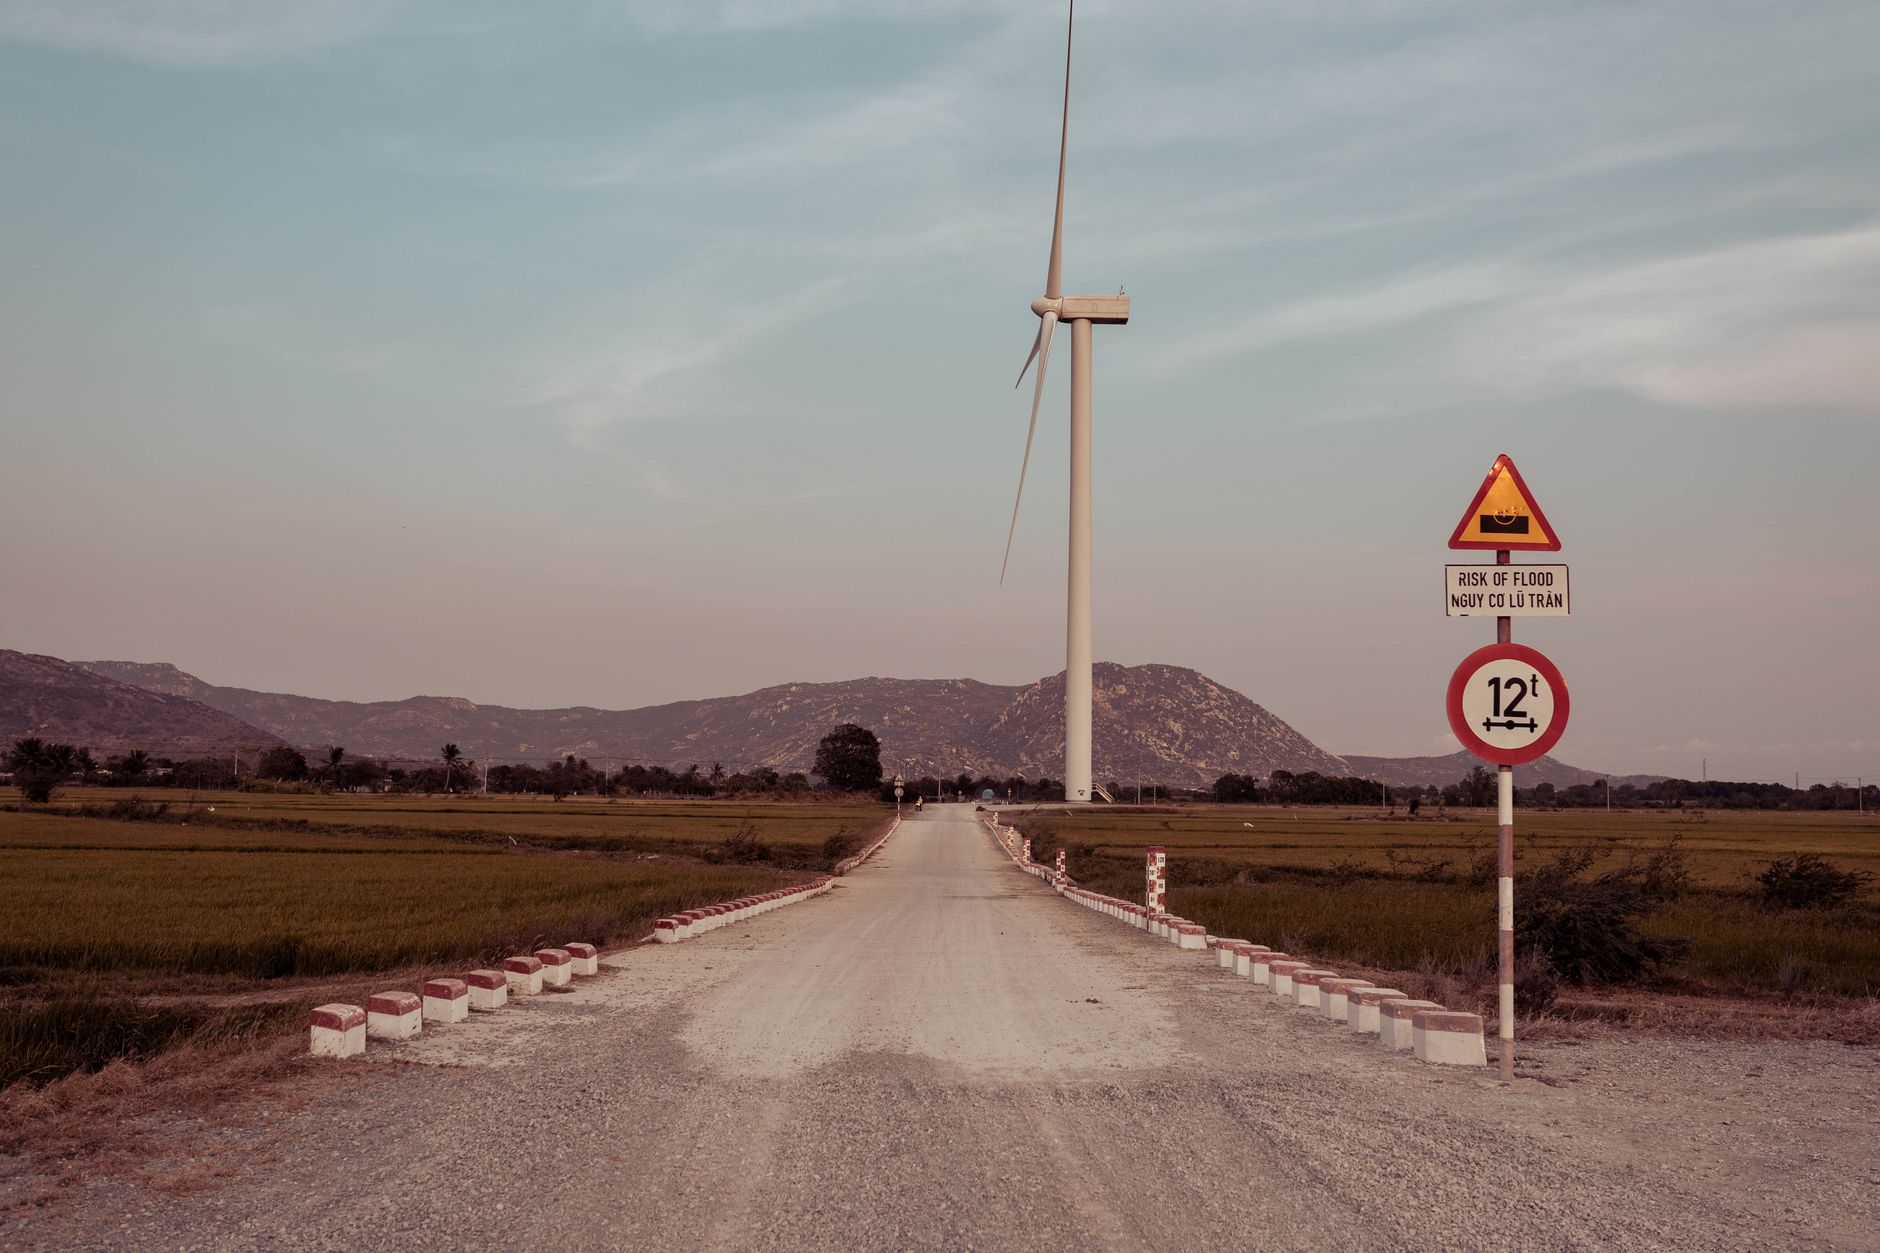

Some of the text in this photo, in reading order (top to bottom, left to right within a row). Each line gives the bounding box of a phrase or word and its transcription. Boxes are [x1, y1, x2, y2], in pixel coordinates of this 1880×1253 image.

[1458, 571, 1554, 587] RISK OF FLOOD
[1451, 593, 1485, 608] NGUY
[1509, 590, 1525, 608] LŨ
[1528, 590, 1563, 608] TRÀN
